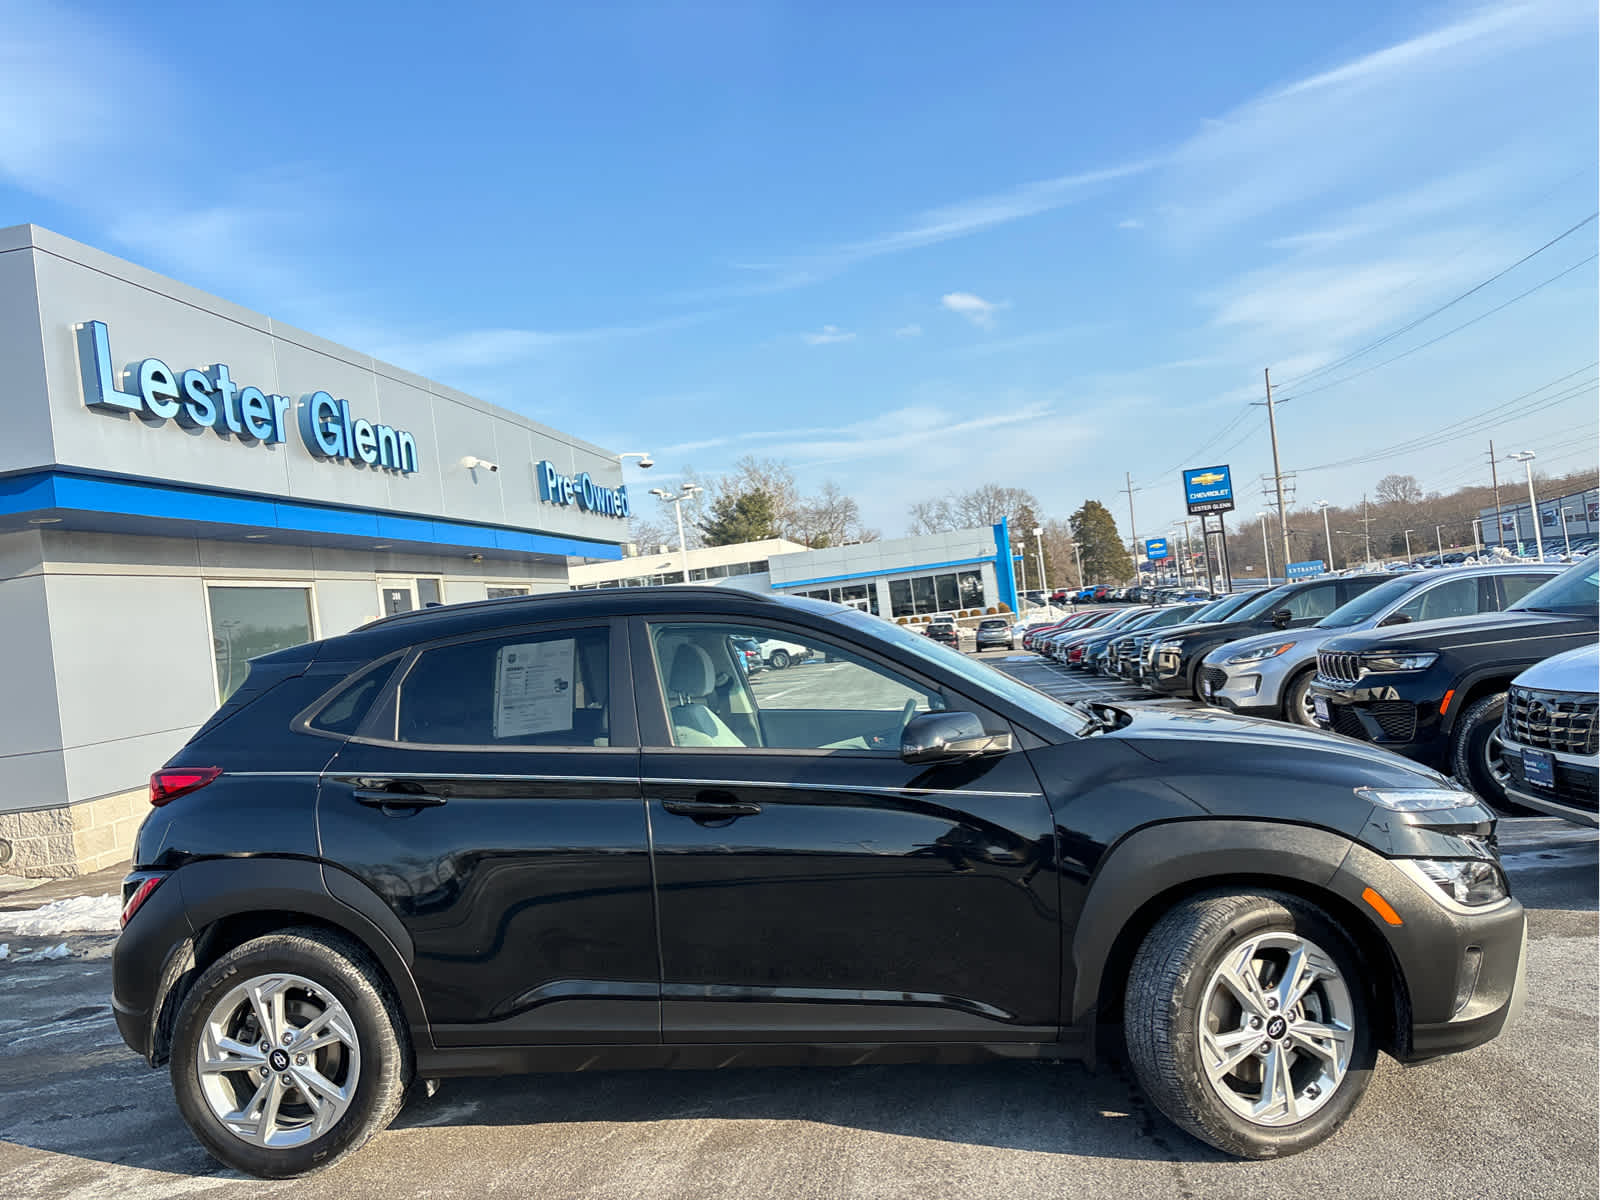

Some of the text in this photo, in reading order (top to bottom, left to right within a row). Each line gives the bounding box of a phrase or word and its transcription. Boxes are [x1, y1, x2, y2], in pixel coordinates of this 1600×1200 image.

[76, 320, 418, 473] Lester Glenn
[537, 460, 630, 517] Pre-Owned
[1190, 489, 1229, 499] CHEVROLET
[1191, 502, 1232, 512] LESTER GLENN
